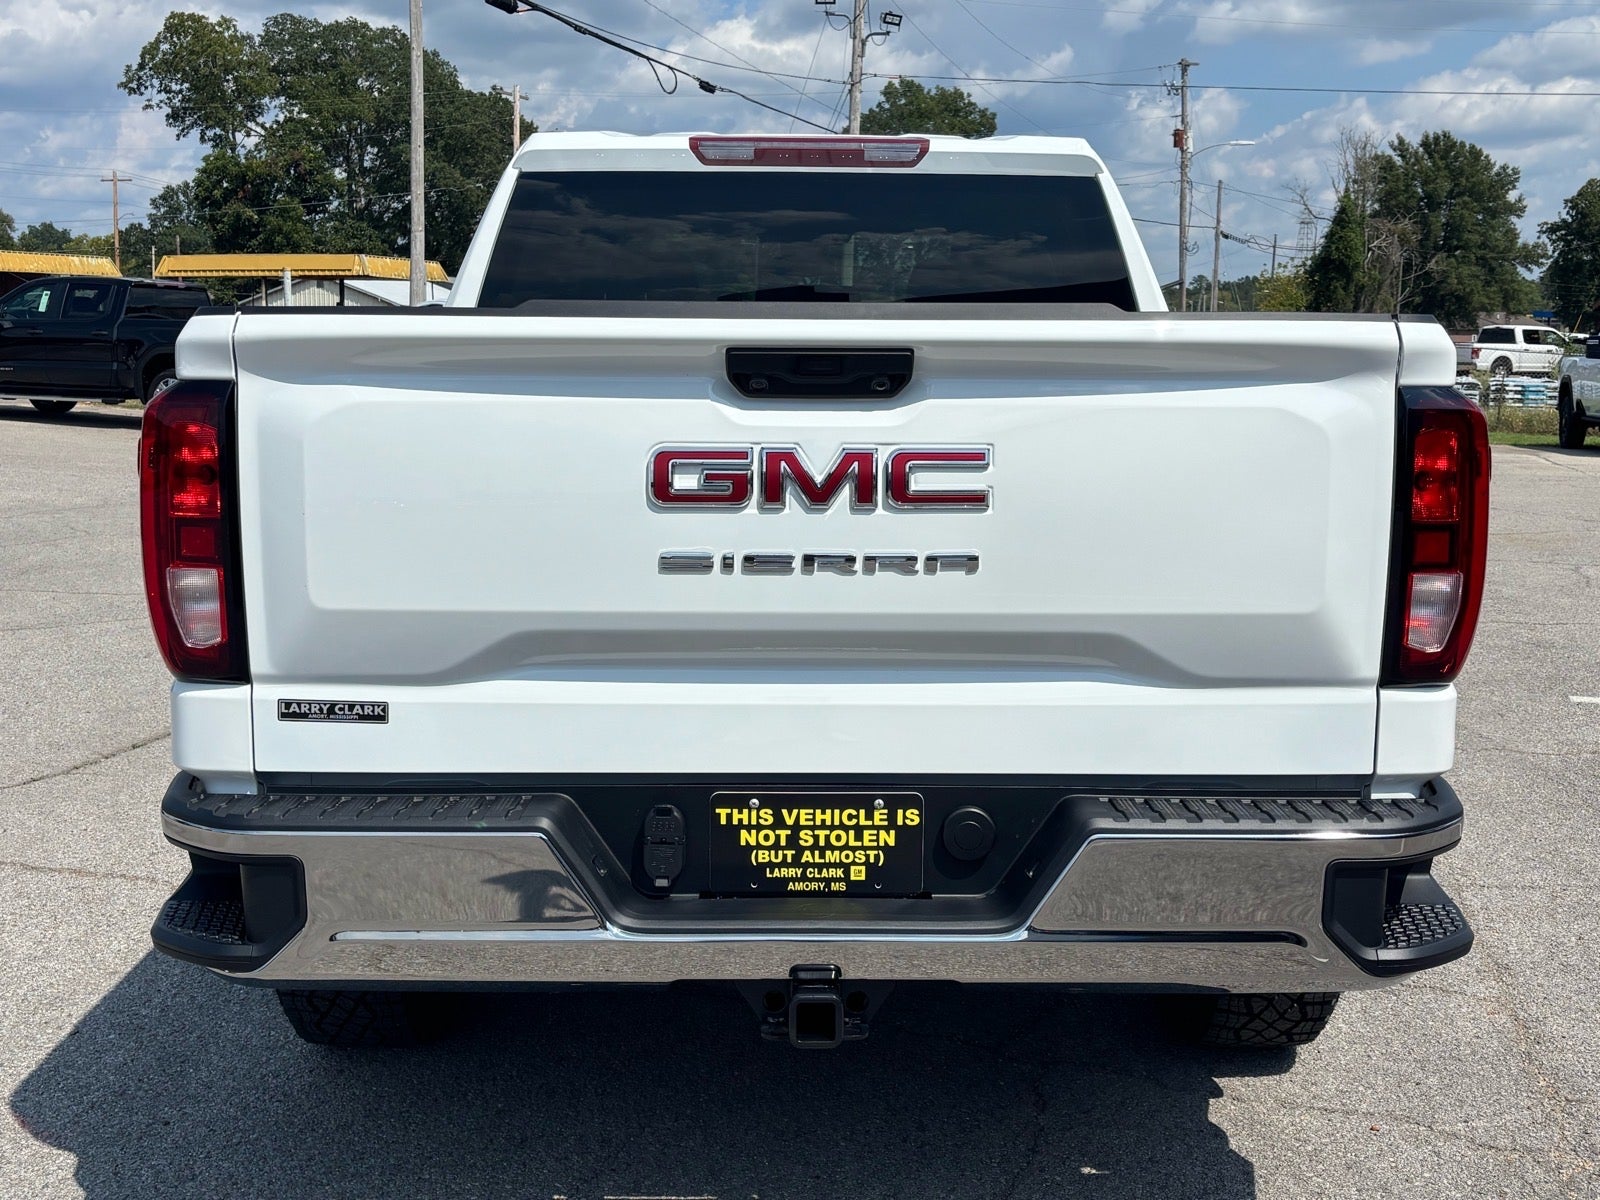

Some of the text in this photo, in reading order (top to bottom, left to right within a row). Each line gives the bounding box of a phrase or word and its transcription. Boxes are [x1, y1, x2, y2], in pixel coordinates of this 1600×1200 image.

[649, 443, 993, 512] GMC
[659, 551, 980, 575] SIERRA
[281, 702, 385, 716] LARRY CLARK
[715, 808, 920, 826] THIS VEHICLE IS
[740, 829, 896, 847] NOT STOLEN
[751, 850, 884, 866] (BUT ALMOST)
[766, 868, 863, 878] LARRY CLARK GM
[787, 881, 847, 892] AMORY, MS
